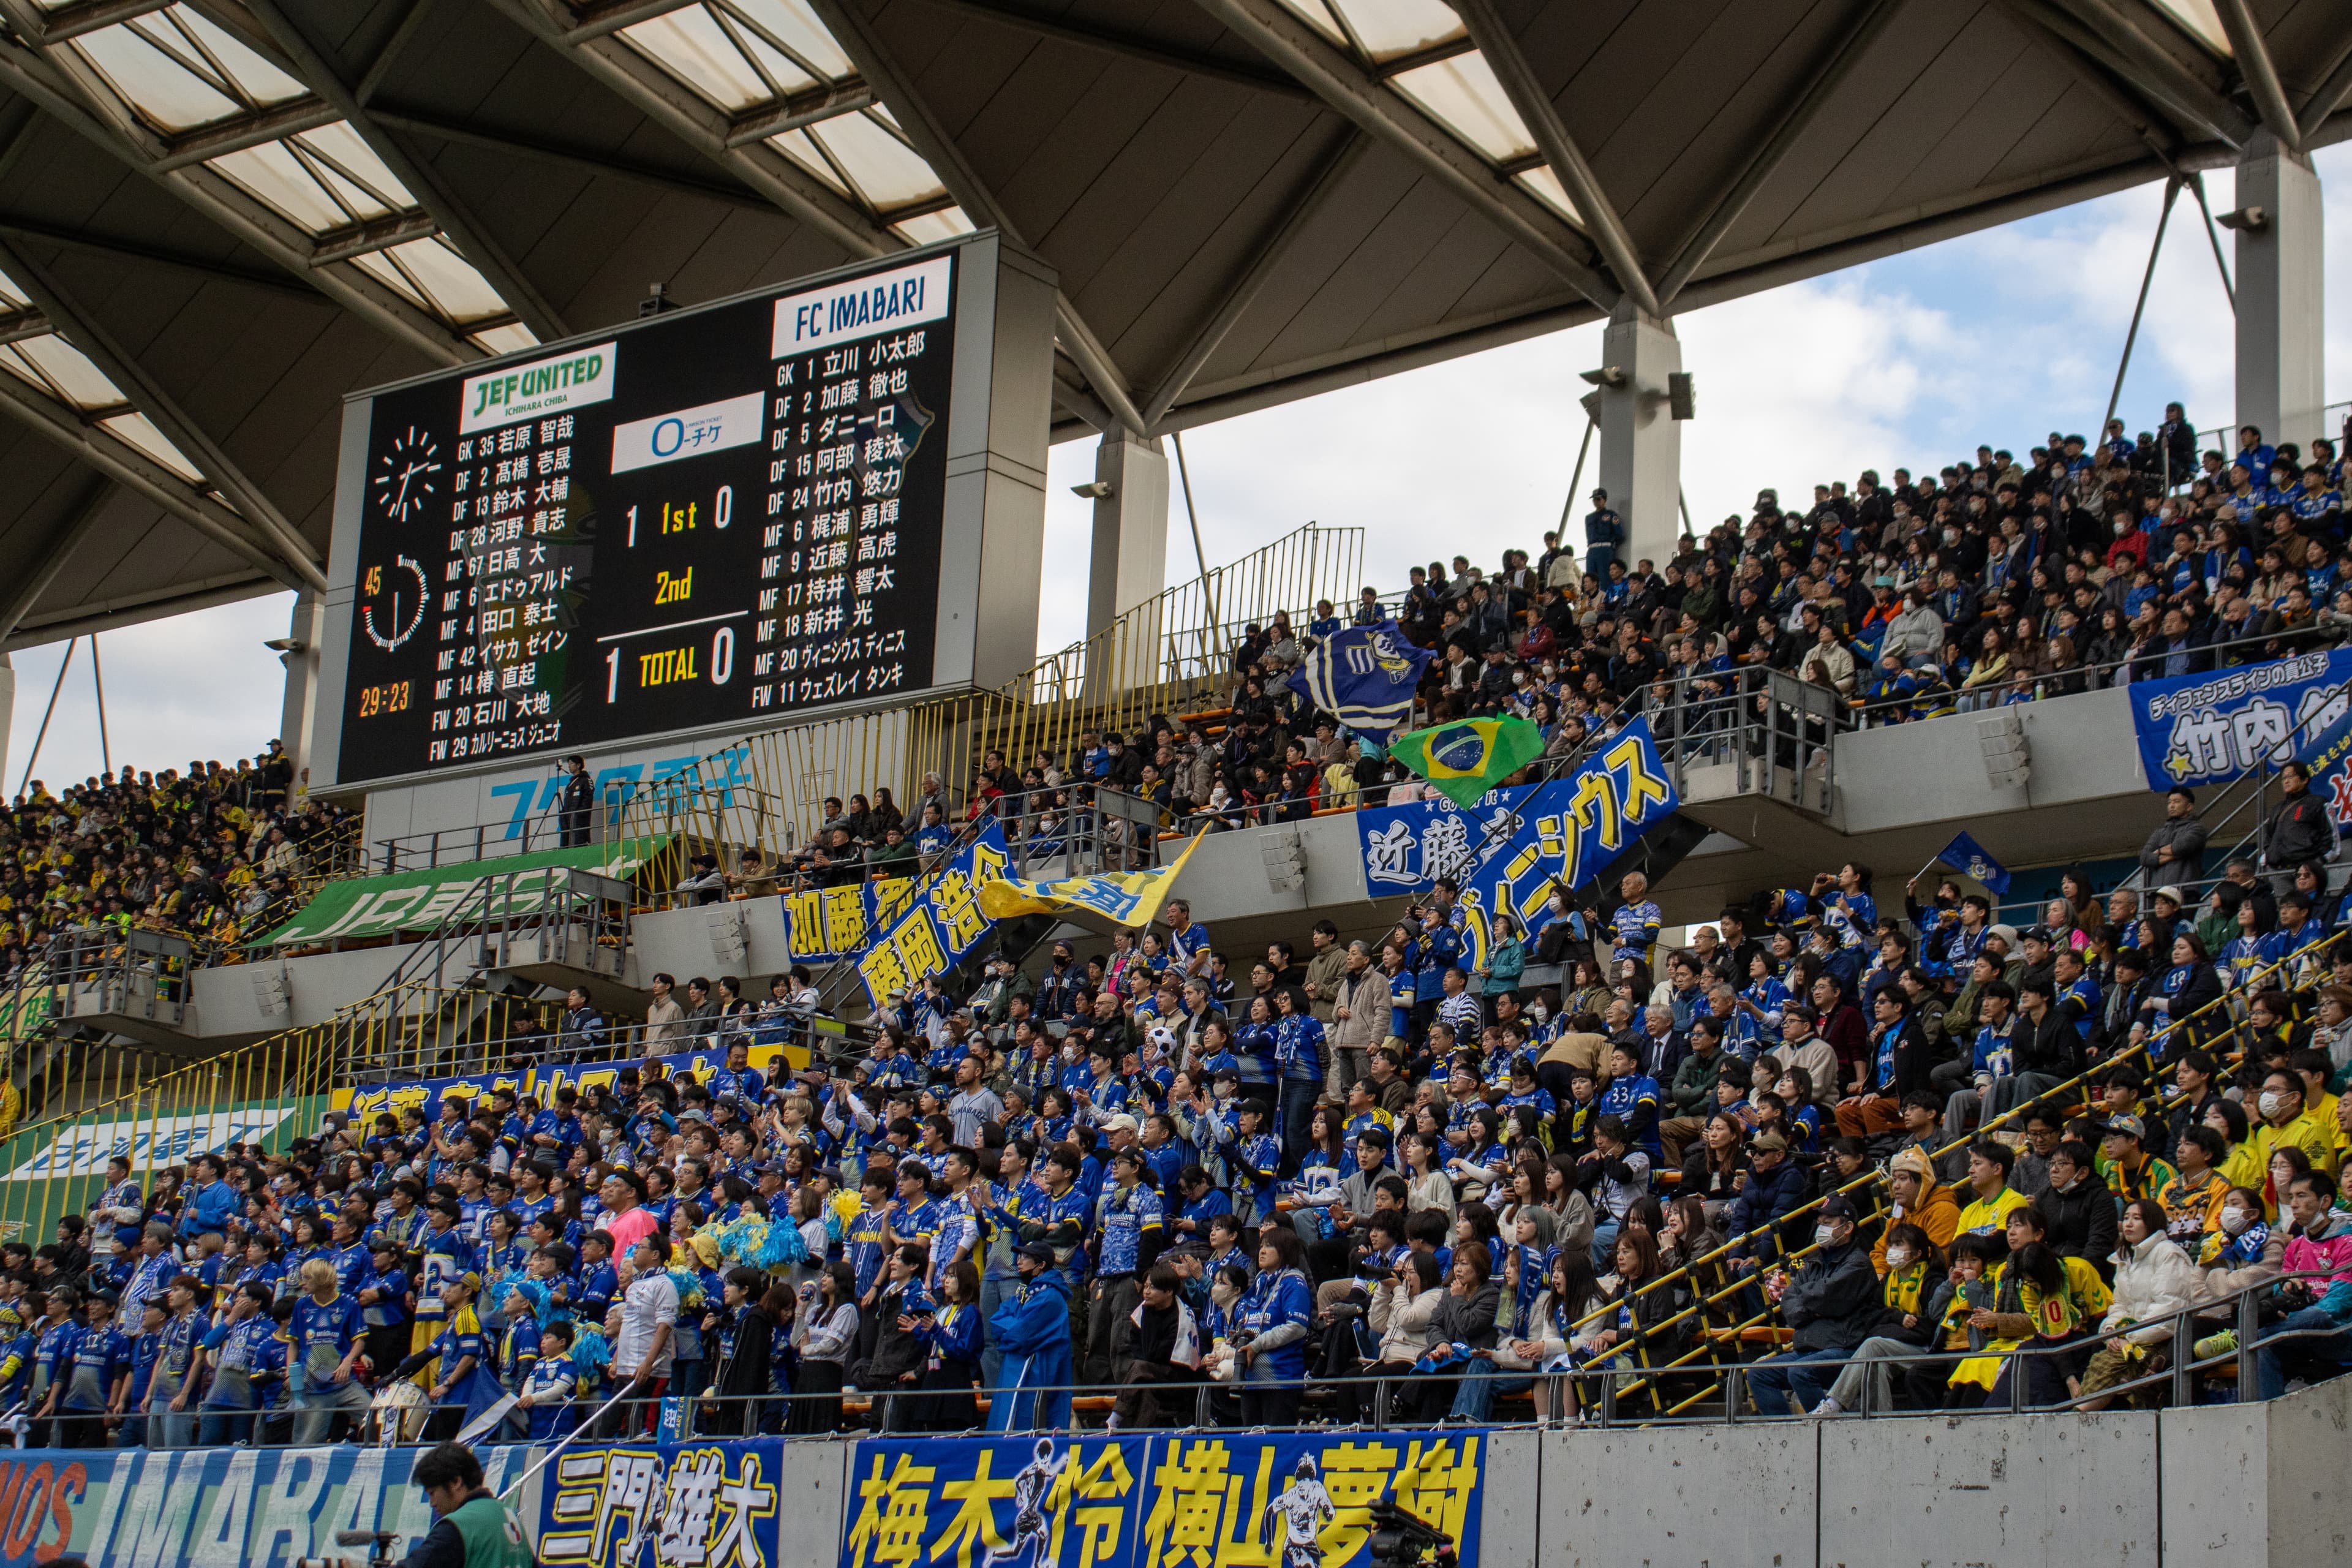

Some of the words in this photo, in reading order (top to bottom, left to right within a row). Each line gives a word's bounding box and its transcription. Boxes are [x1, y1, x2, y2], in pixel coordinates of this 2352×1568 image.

[796, 301, 823, 342] FC
[829, 275, 925, 333] IMABARI
[777, 363, 794, 386] GK
[807, 358, 813, 380] 1
[823, 346, 859, 377] 立川
[869, 331, 925, 366] 小太郎
[473, 374, 519, 418] JEF
[521, 353, 603, 397] UNITED
[505, 402, 542, 417] ICHIHARA
[544, 394, 568, 407] CHIBA
[775, 396, 791, 420] DF
[803, 391, 812, 413] 2
[820, 378, 859, 410] 加藤
[869, 368, 908, 399] 徹也
[459, 440, 473, 461] GK
[480, 435, 494, 457] 35
[498, 424, 532, 454] 若原
[540, 415, 574, 445] 智哉
[772, 428, 789, 451] DF
[801, 423, 810, 444] 5
[819, 404, 895, 442] ダニーロ
[456, 470, 470, 492] DF
[480, 467, 489, 487] 2
[770, 459, 787, 483] DF
[797, 454, 812, 477] 15
[816, 443, 855, 475] 阿部
[864, 432, 903, 464] 稜汰
[453, 500, 468, 522] DF
[476, 496, 489, 516] 13
[492, 486, 526, 514] 鈴木
[534, 476, 569, 505] 大輔
[768, 492, 785, 515] DF
[792, 486, 809, 511] 24
[814, 476, 852, 507] 竹内
[862, 466, 901, 497] 悠力
[450, 530, 466, 551] DF
[471, 525, 486, 546] 28
[490, 516, 524, 544] 河野
[532, 506, 567, 535] 貴志
[627, 505, 637, 547] 1
[662, 502, 697, 534] 1st
[715, 485, 733, 529] 0
[764, 524, 783, 548] MF
[793, 520, 803, 542] 6
[811, 508, 851, 540] 梶浦
[860, 498, 900, 530] 勇輝
[446, 559, 464, 581] MF
[468, 555, 484, 576] 67
[488, 546, 521, 574] 日高
[529, 541, 546, 566] 大
[761, 555, 781, 579] MF
[791, 551, 801, 573] 9
[809, 540, 848, 571] 近藤
[858, 531, 897, 562] 高虎
[365, 566, 382, 596] 45
[443, 590, 461, 611] MF
[469, 587, 477, 606] 6
[484, 565, 573, 602] エドゥアルド
[655, 566, 693, 605] 2nd
[759, 587, 779, 611] MF
[787, 583, 802, 606] 17
[806, 573, 845, 605] 持井
[855, 564, 895, 595] 響太
[440, 619, 458, 641] MF
[466, 615, 475, 635] 4
[482, 607, 515, 634] 田口
[524, 598, 558, 627] 泰士
[756, 619, 777, 643] MF
[785, 614, 800, 638] 18
[804, 604, 843, 636] 新井
[853, 599, 873, 627] 光
[437, 649, 456, 671] MF
[460, 646, 476, 666] 42
[480, 637, 519, 664] イサカ
[527, 630, 568, 657] ゼイン
[606, 647, 619, 703] 1
[639, 646, 698, 687] TOTAL
[711, 627, 734, 685] 0
[754, 652, 774, 676] MF
[780, 647, 797, 671] 20
[802, 637, 861, 669] ヴィニシウス
[865, 629, 905, 658] ディニス
[360, 681, 409, 717] 29:23
[435, 678, 453, 700] MF
[459, 674, 473, 696] 14
[477, 669, 494, 695] 椿
[502, 662, 536, 690] 直起
[752, 685, 772, 709] FW
[780, 680, 795, 704] 11
[800, 669, 861, 701] ウェズレイ
[866, 662, 903, 692] タンキ
[2150, 652, 2328, 720] ディフェンスラインの貴公子
[432, 709, 450, 731] FW
[454, 706, 470, 728] 20
[474, 699, 507, 725] 石川
[516, 690, 551, 718] 大地
[429, 739, 448, 761] FW
[451, 736, 468, 758] 29
[1439, 796, 1457, 812] Go
[1485, 788, 1497, 807] it
[1611, 1087, 1629, 1104] 33
[859, 1230, 882, 1243] IMABAR
[2042, 1300, 2062, 1324] 10
[85, 1333, 99, 1349] 12
[86, 1446, 514, 1568] IMABA
[540, 1446, 777, 1568] 三門雄大
